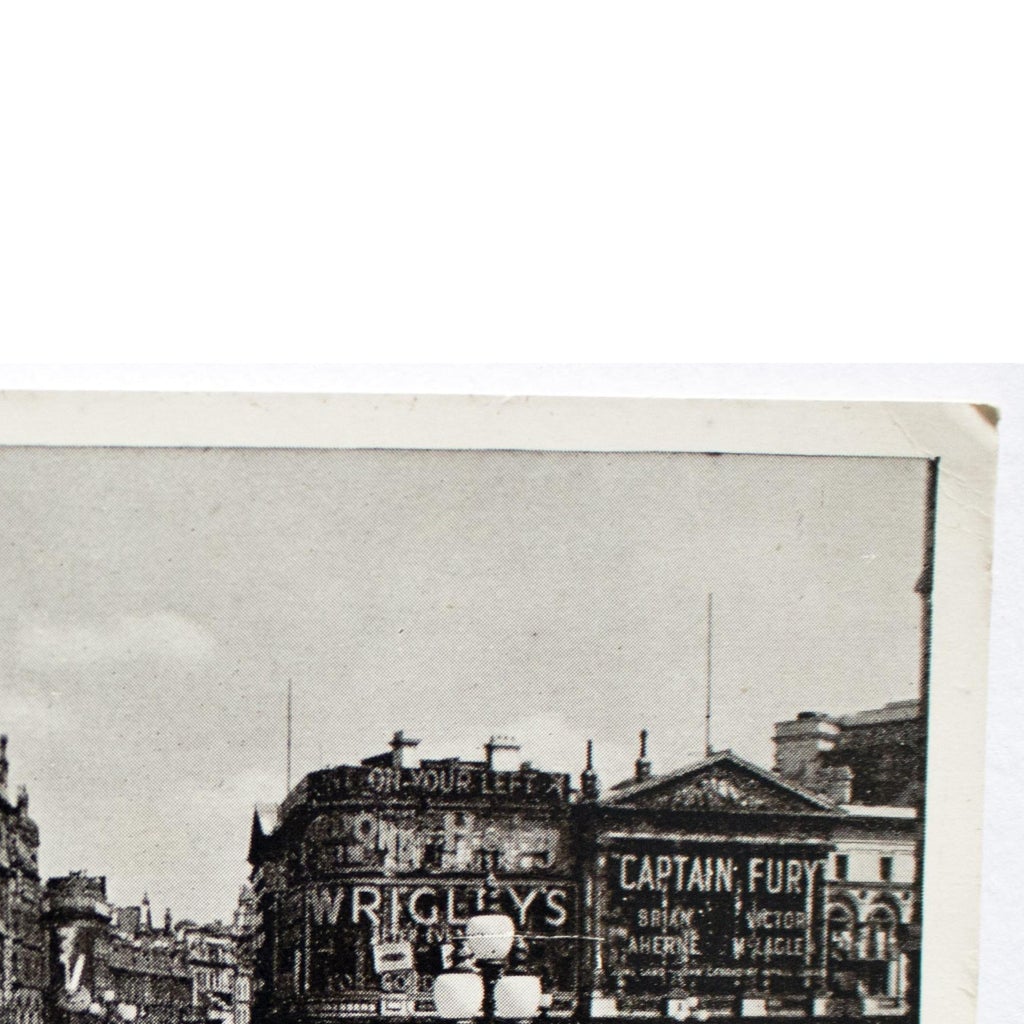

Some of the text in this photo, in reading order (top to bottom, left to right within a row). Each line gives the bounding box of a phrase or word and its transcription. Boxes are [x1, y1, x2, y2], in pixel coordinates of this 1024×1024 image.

[619, 854, 822, 894] CAPTAIN FURY
[637, 908, 695, 928] BRIAN
